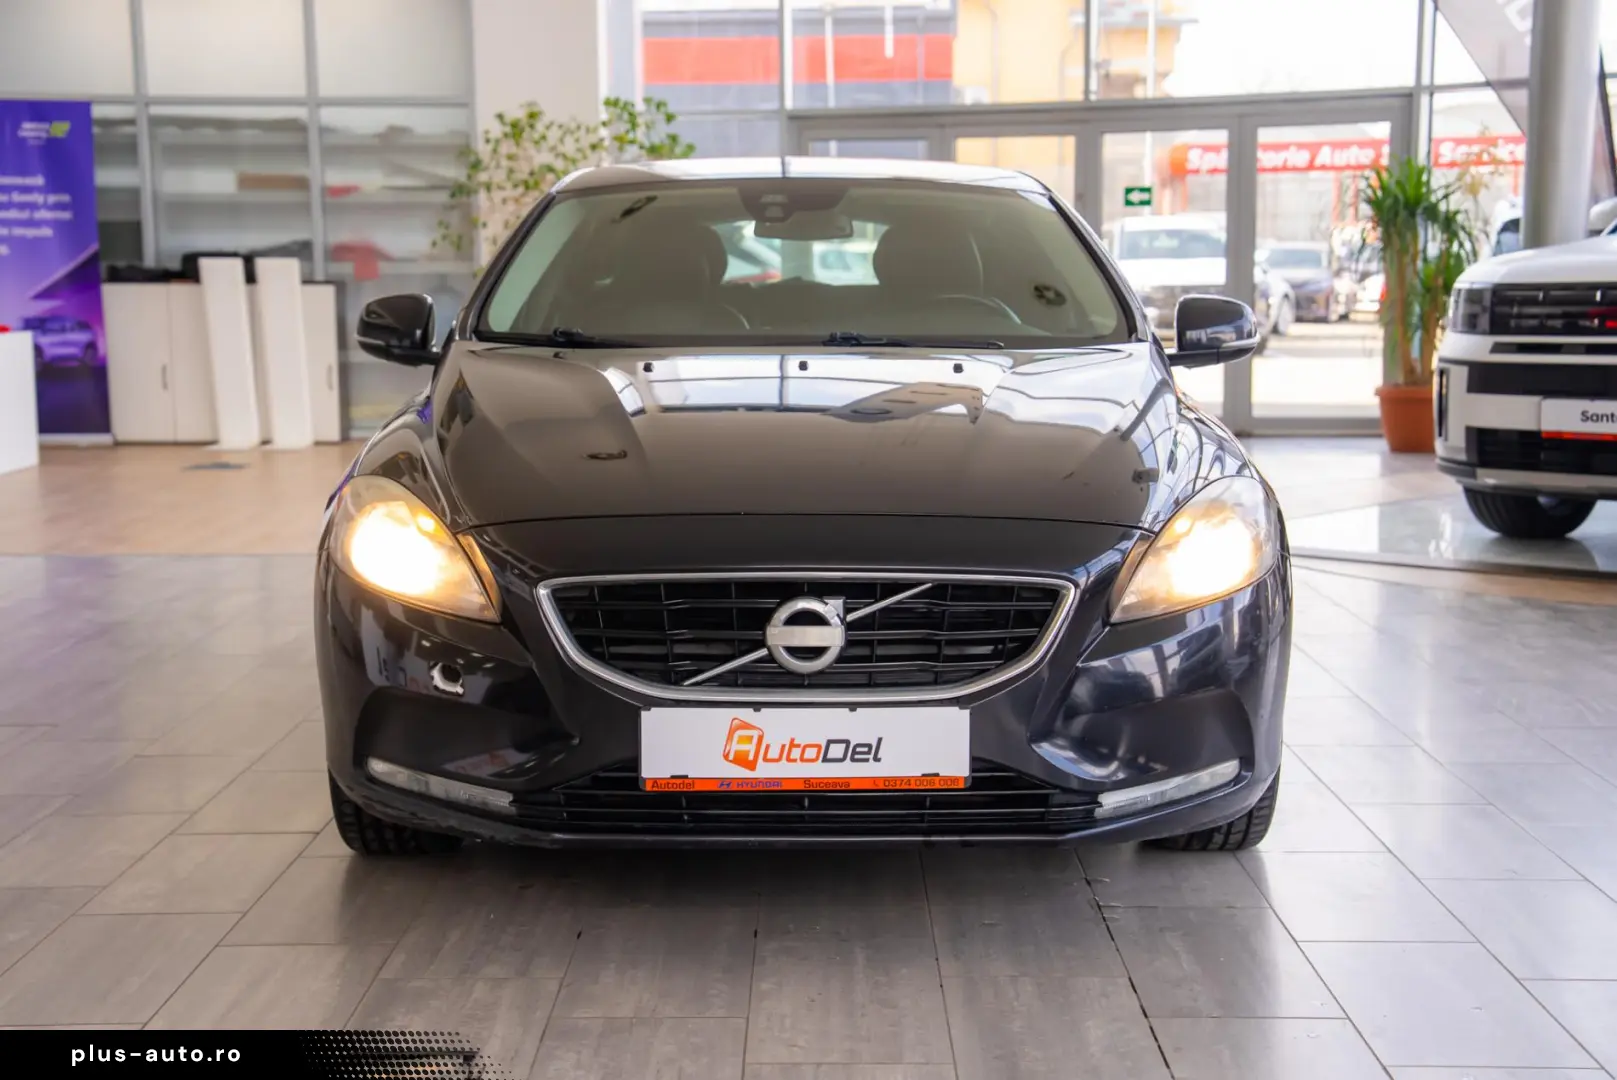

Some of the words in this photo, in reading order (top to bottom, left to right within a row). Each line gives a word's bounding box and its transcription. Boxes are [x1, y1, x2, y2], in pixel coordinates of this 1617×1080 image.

[1314, 144, 1376, 167] Auto
[1580, 409, 1617, 424] Sant
[727, 727, 884, 765] AutoDel
[651, 780, 695, 790] Autodel
[736, 780, 782, 789] HYUNDAI
[803, 779, 850, 789] Suceava
[883, 778, 912, 788] 0374
